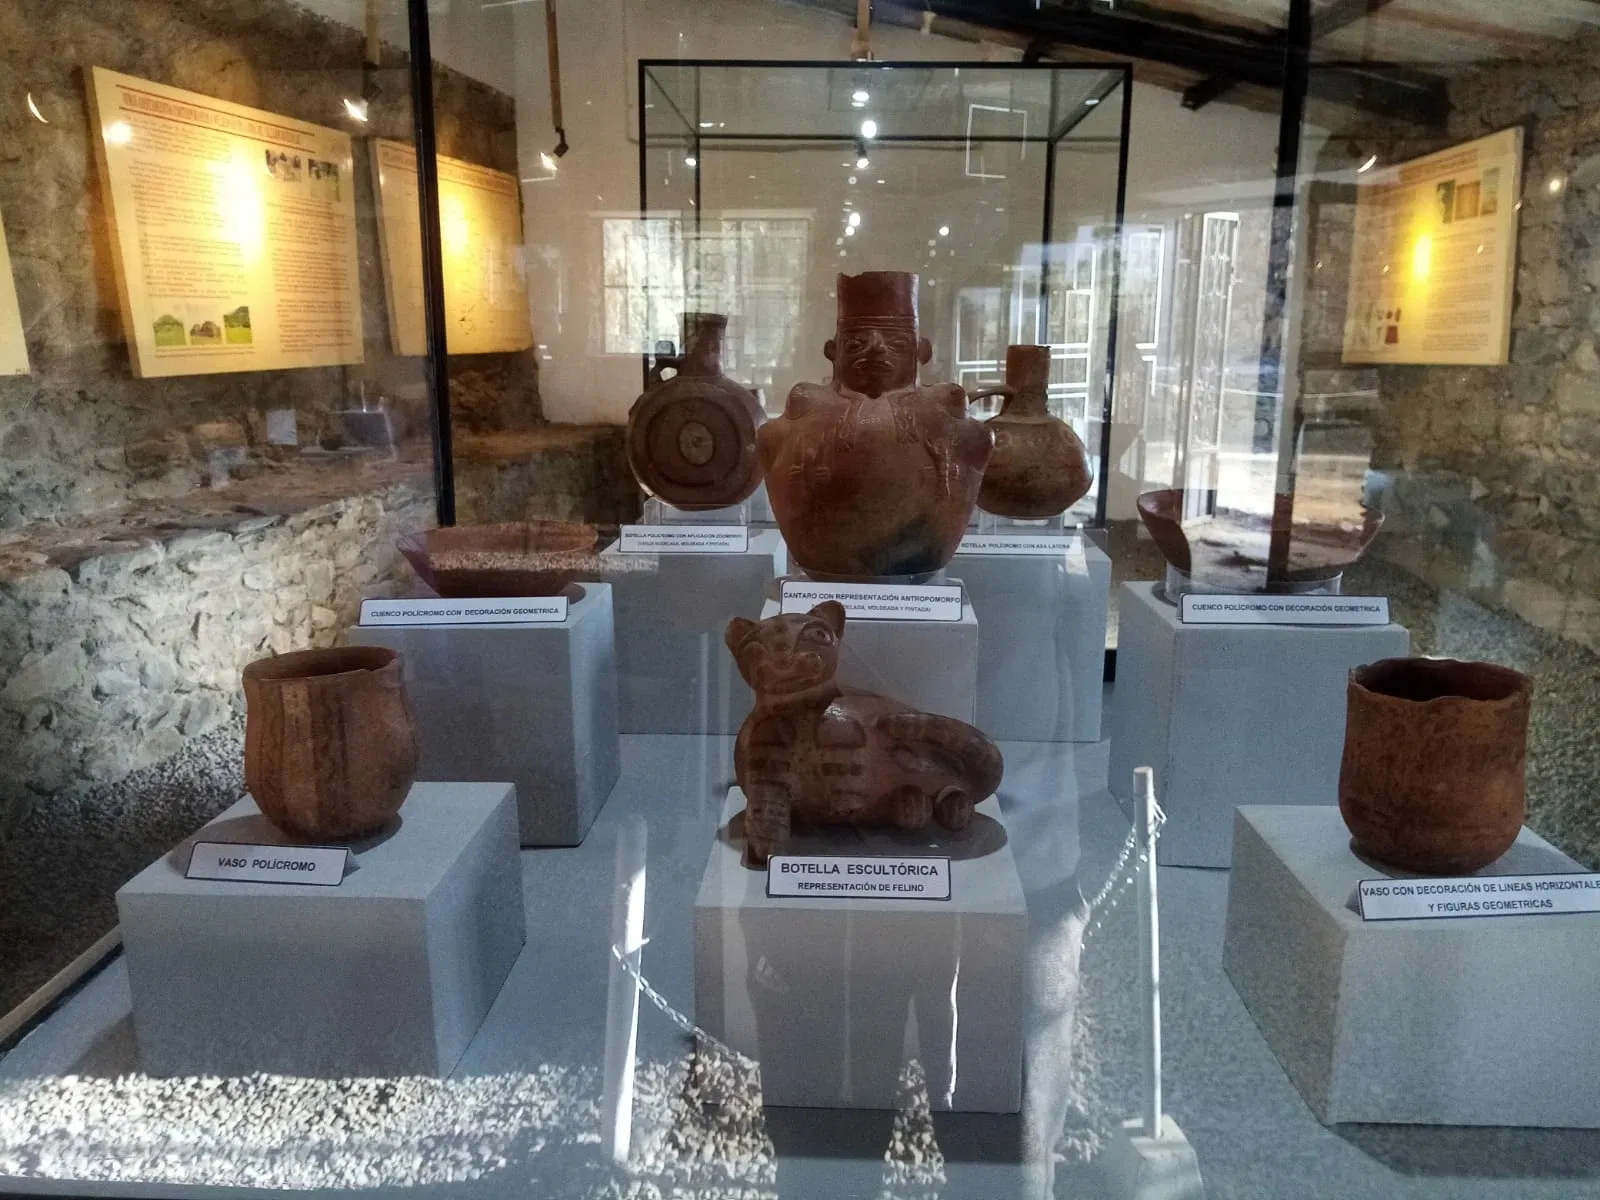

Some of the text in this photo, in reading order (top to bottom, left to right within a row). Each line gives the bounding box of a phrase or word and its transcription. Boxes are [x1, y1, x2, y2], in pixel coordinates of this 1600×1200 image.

[783, 592, 818, 600] CANTARO
[836, 592, 900, 602] REPRESENTACIÓN
[901, 595, 961, 604] ANTROPOMORFO
[402, 609, 445, 617] POLÍCROMO
[464, 607, 512, 616] DECORACIÓN
[512, 607, 559, 615] GEOMETRICA
[1191, 603, 1223, 611] CUENCO
[1224, 603, 1267, 612] POLÍCROMO
[1284, 604, 1333, 612] DECORACIÓN
[1334, 605, 1381, 613] GEOMETRICA
[218, 857, 316, 871] VASO POLÍCROMO
[781, 862, 938, 876] BOTELLA ESCULTÓRICA
[798, 882, 877, 892] REPRESENTACIÓN
[892, 884, 924, 892] FELINO
[1361, 880, 1600, 897] VASO CON DECORACIÓN DE LINEAS HORIZONTALE
[1428, 899, 1553, 912] Y FIGURAS GEOMETRICAS
